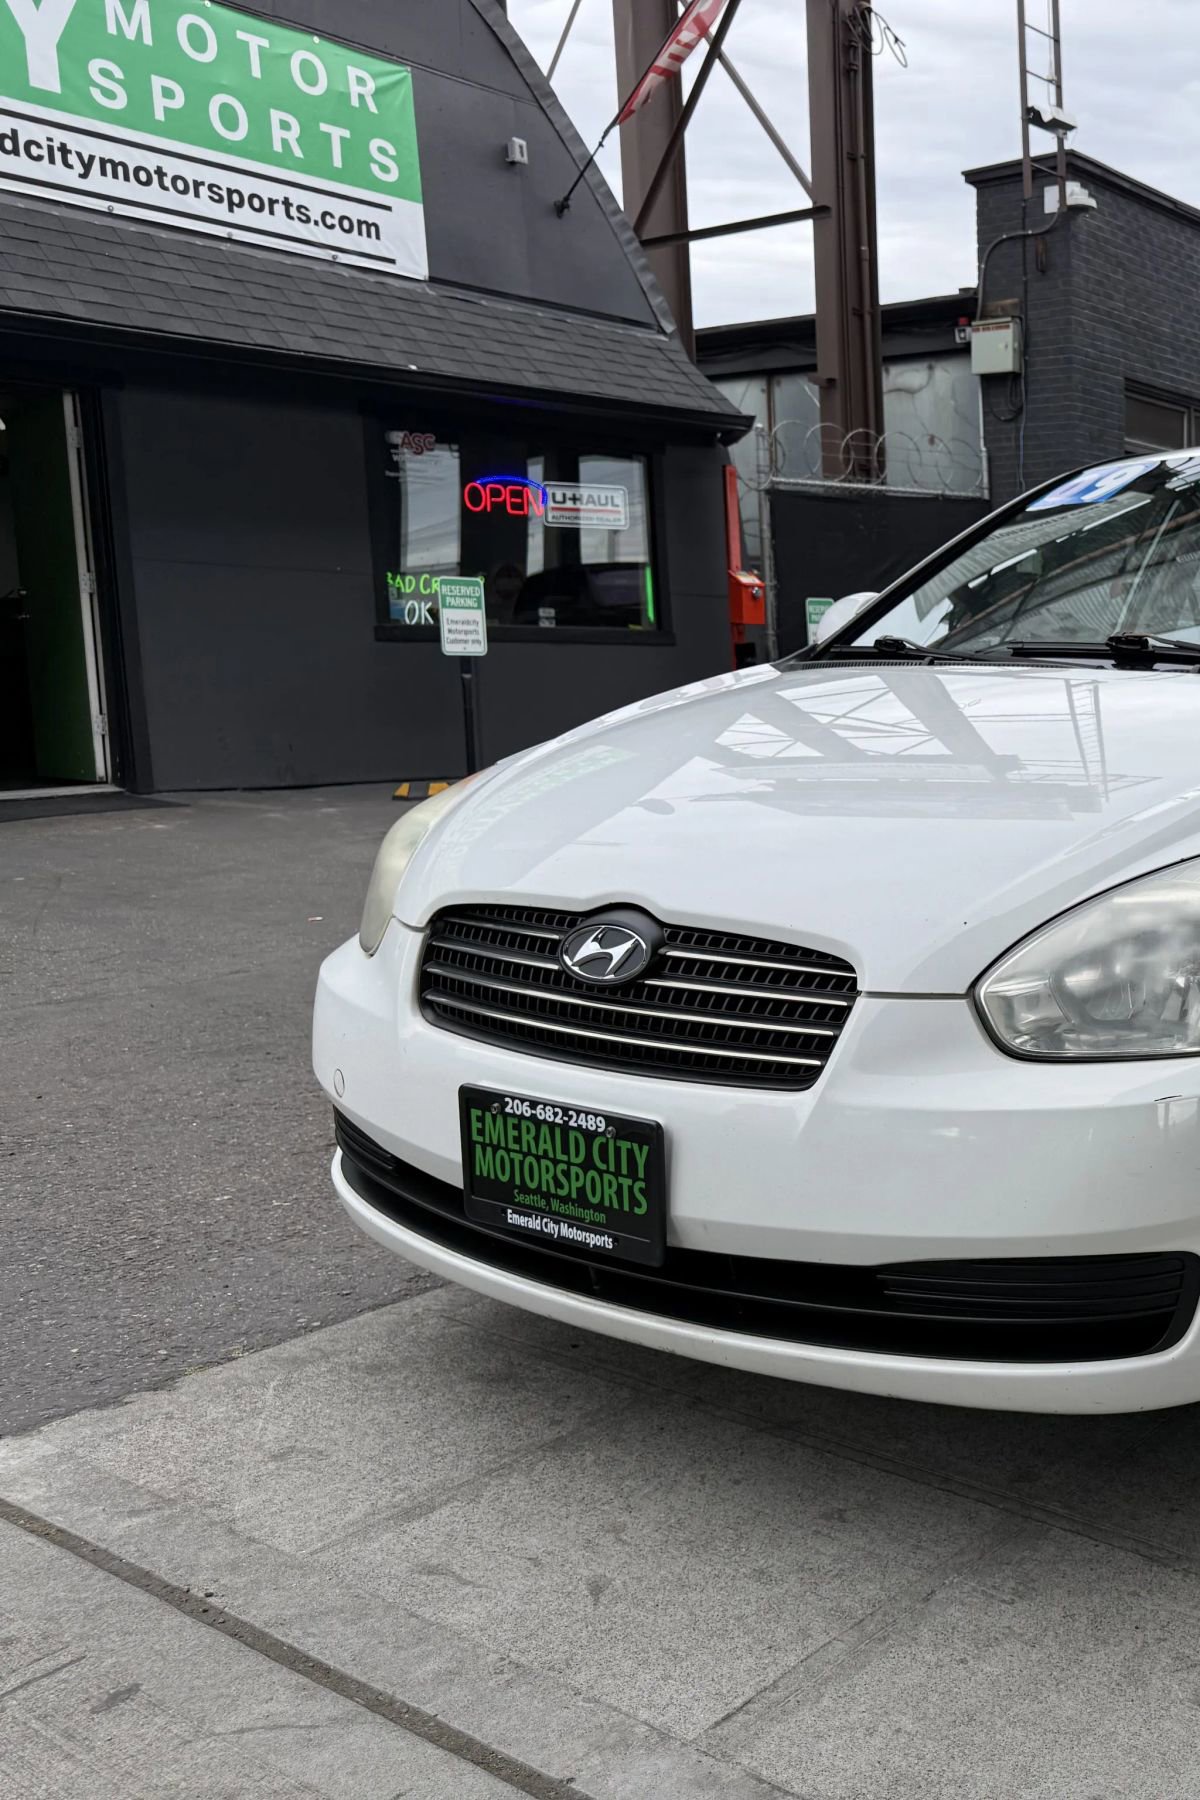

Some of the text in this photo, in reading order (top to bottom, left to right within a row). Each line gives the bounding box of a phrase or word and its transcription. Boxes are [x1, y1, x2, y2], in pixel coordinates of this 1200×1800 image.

[104, 0, 379, 114] MOTOR
[87, 58, 400, 182] SPORTS
[464, 482, 544, 517] OPEN
[441, 584, 481, 598] RESERVED
[446, 597, 478, 608] PARKING
[405, 600, 434, 625] OK
[504, 1097, 606, 1133] 206-682-2489
[470, 1108, 649, 1179] EMERALD CITY
[474, 1143, 648, 1216] MOTORSPORTS
[513, 1189, 607, 1225] Seattle, Washington
[507, 1208, 614, 1249] Emerald City Motorsports
